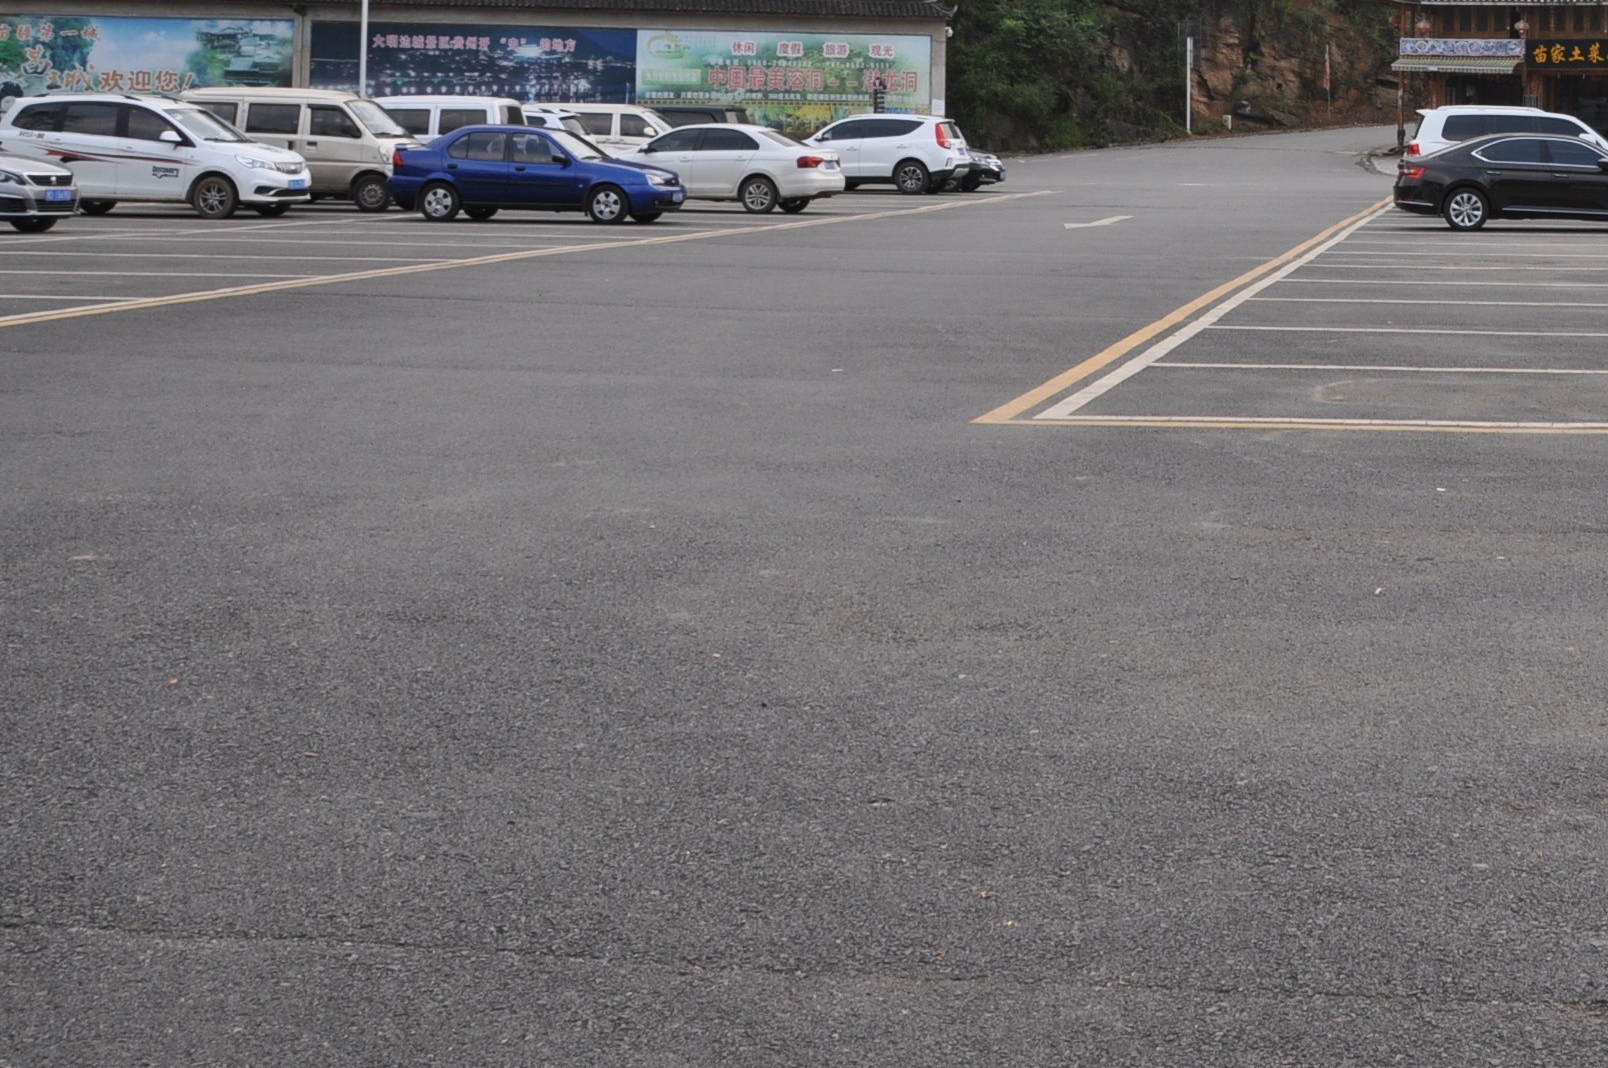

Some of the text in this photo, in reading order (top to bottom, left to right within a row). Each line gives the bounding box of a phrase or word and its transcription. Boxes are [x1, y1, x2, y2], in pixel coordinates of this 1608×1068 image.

[731, 41, 757, 55] 休闲
[777, 41, 804, 56] 度假
[824, 43, 850, 58] 旅游
[869, 44, 895, 58] 观光
